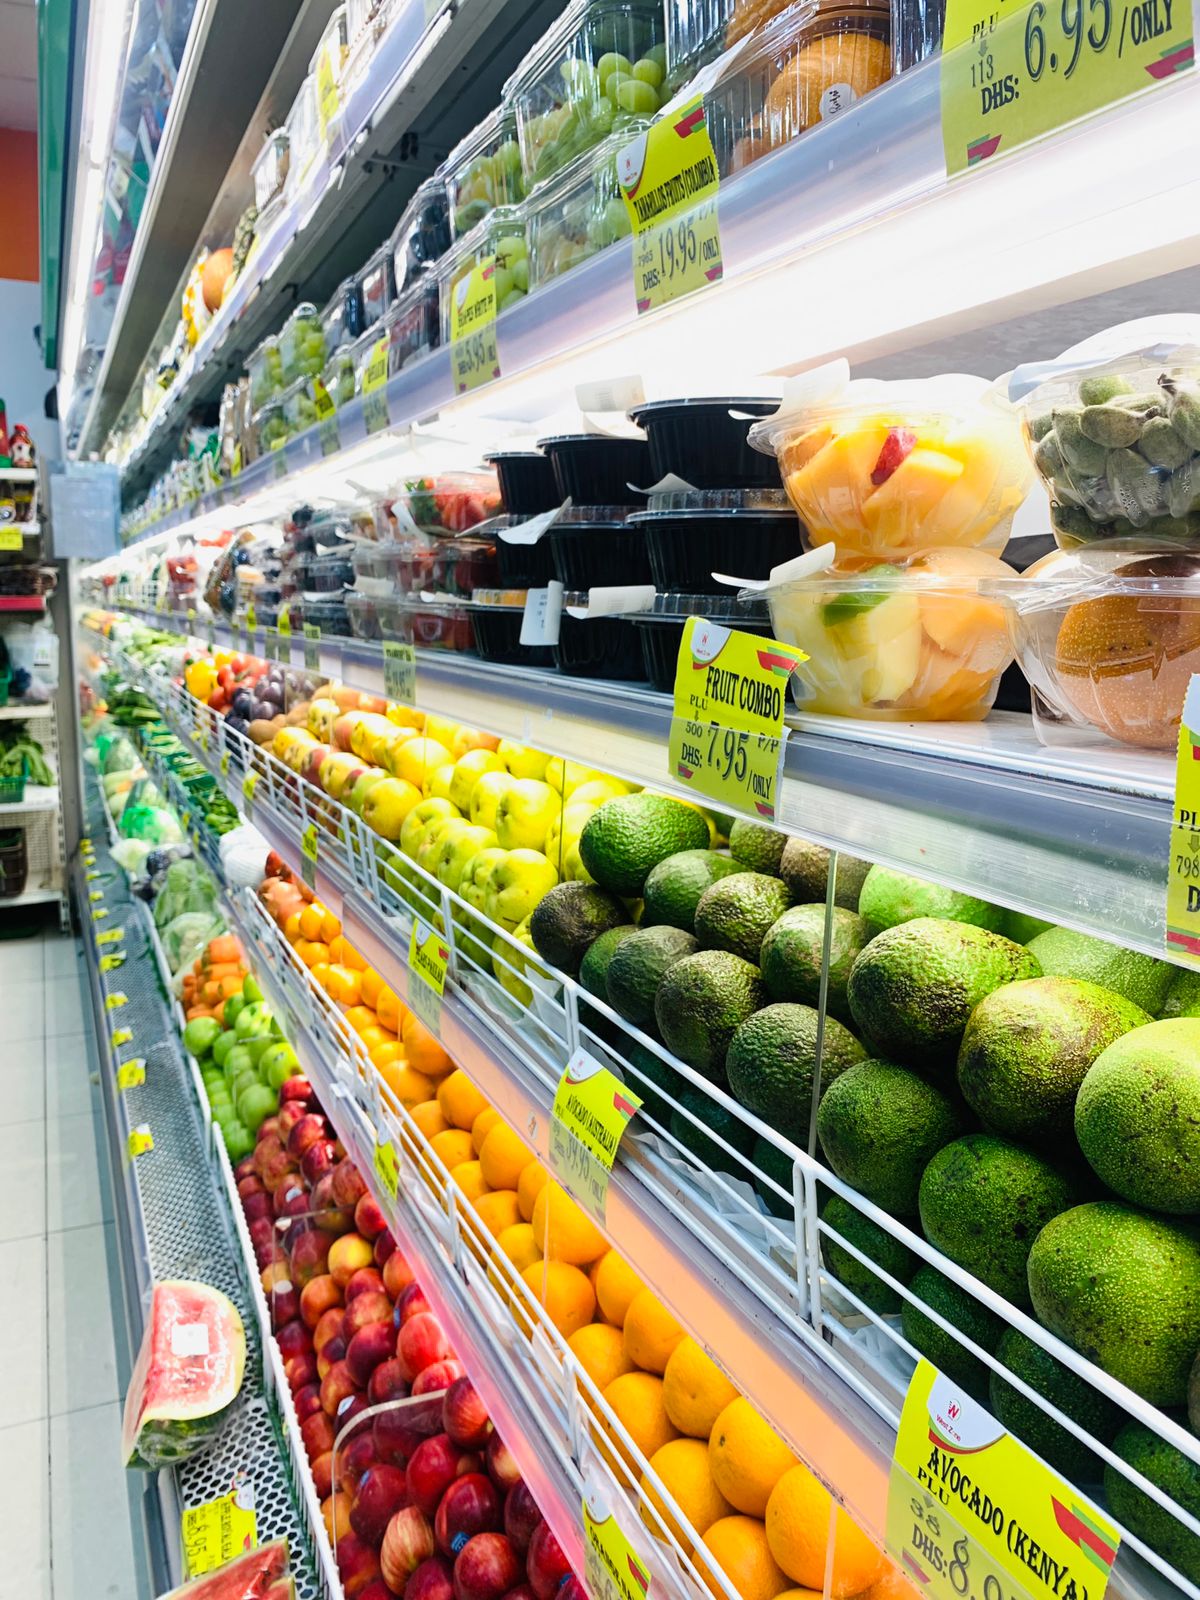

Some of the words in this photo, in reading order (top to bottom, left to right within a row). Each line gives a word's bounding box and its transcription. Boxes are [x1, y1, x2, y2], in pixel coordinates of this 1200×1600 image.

[972, 12, 998, 43] PLU
[1024, 0, 1113, 82] 6.95
[971, 54, 994, 88] 113
[981, 75, 1020, 115] DHS:
[659, 215, 696, 281] 19.95
[642, 268, 660, 291] DHS:
[690, 694, 708, 711] PLU
[706, 666, 740, 706] FRUIT
[740, 676, 781, 722] COMBO
[682, 743, 703, 769] DHS:
[686, 721, 702, 738] 500
[707, 721, 750, 781] 7.95
[1178, 809, 1200, 832] PL
[1176, 855, 1200, 878] 798
[917, 1465, 950, 1506] PLU
[927, 1446, 1005, 1536] AVOCADO
[912, 1523, 949, 1579] DHS:
